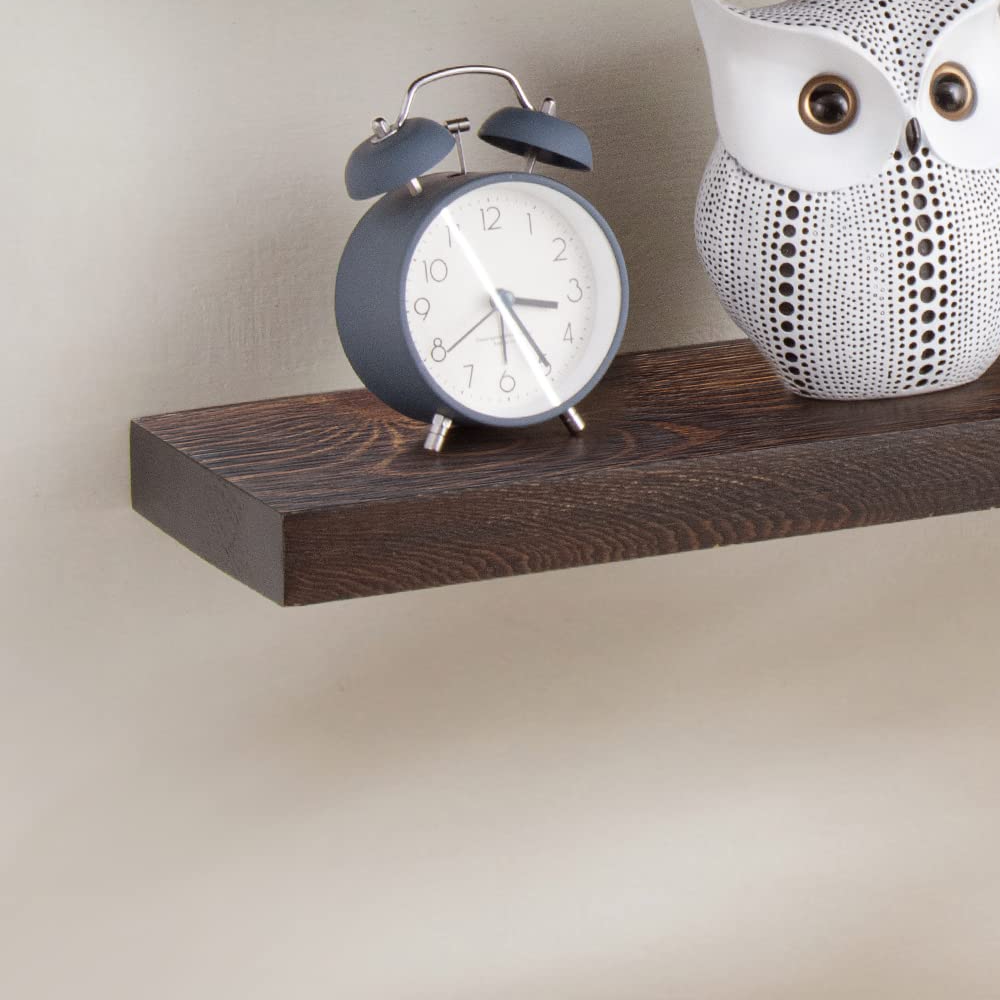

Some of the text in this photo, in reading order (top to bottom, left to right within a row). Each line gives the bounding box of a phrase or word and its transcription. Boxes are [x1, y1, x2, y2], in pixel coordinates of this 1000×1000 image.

[480, 206, 502, 232] 12
[526, 212, 533, 236] 1
[551, 237, 568, 262] 2
[422, 258, 448, 284] 10
[566, 277, 583, 303] 3
[413, 297, 431, 321] 9
[562, 322, 574, 345] 4
[430, 337, 447, 363] 8
[463, 364, 474, 389] 7
[499, 370, 516, 393] 6
